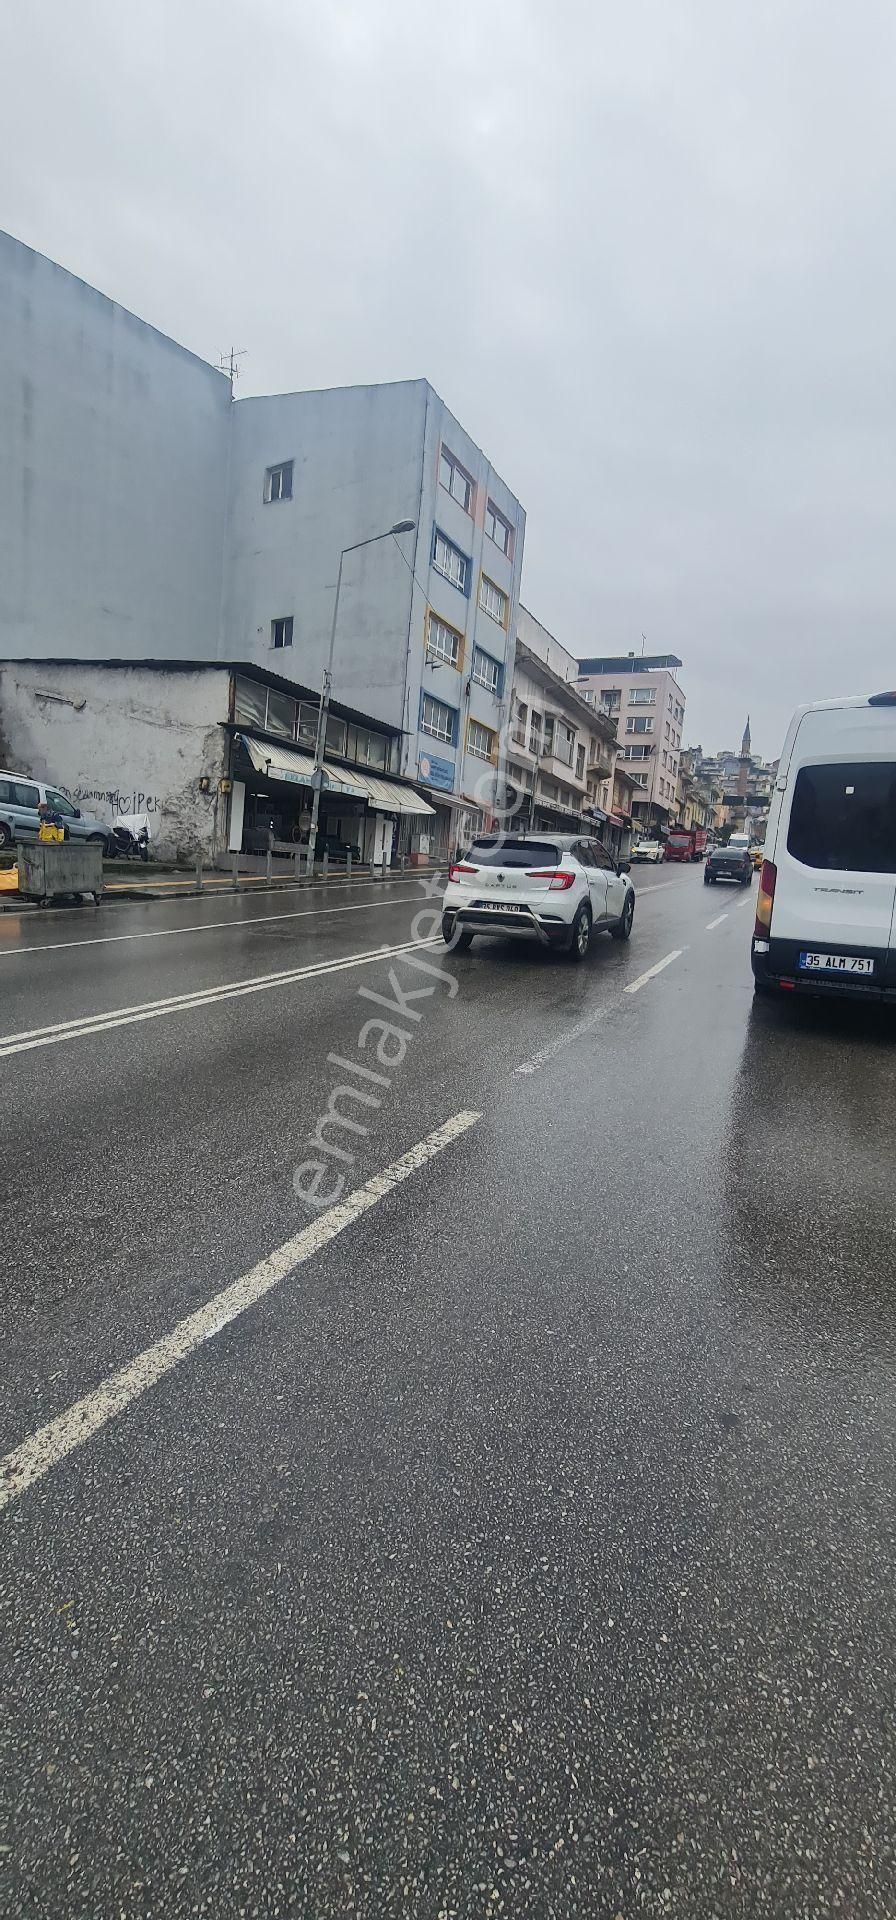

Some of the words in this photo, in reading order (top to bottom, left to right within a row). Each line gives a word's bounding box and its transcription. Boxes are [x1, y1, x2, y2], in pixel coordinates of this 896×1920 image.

[813, 887, 864, 895] TRANSIT
[807, 956, 820, 966] 35
[825, 957, 846, 969] ALM
[851, 959, 870, 971] 751
